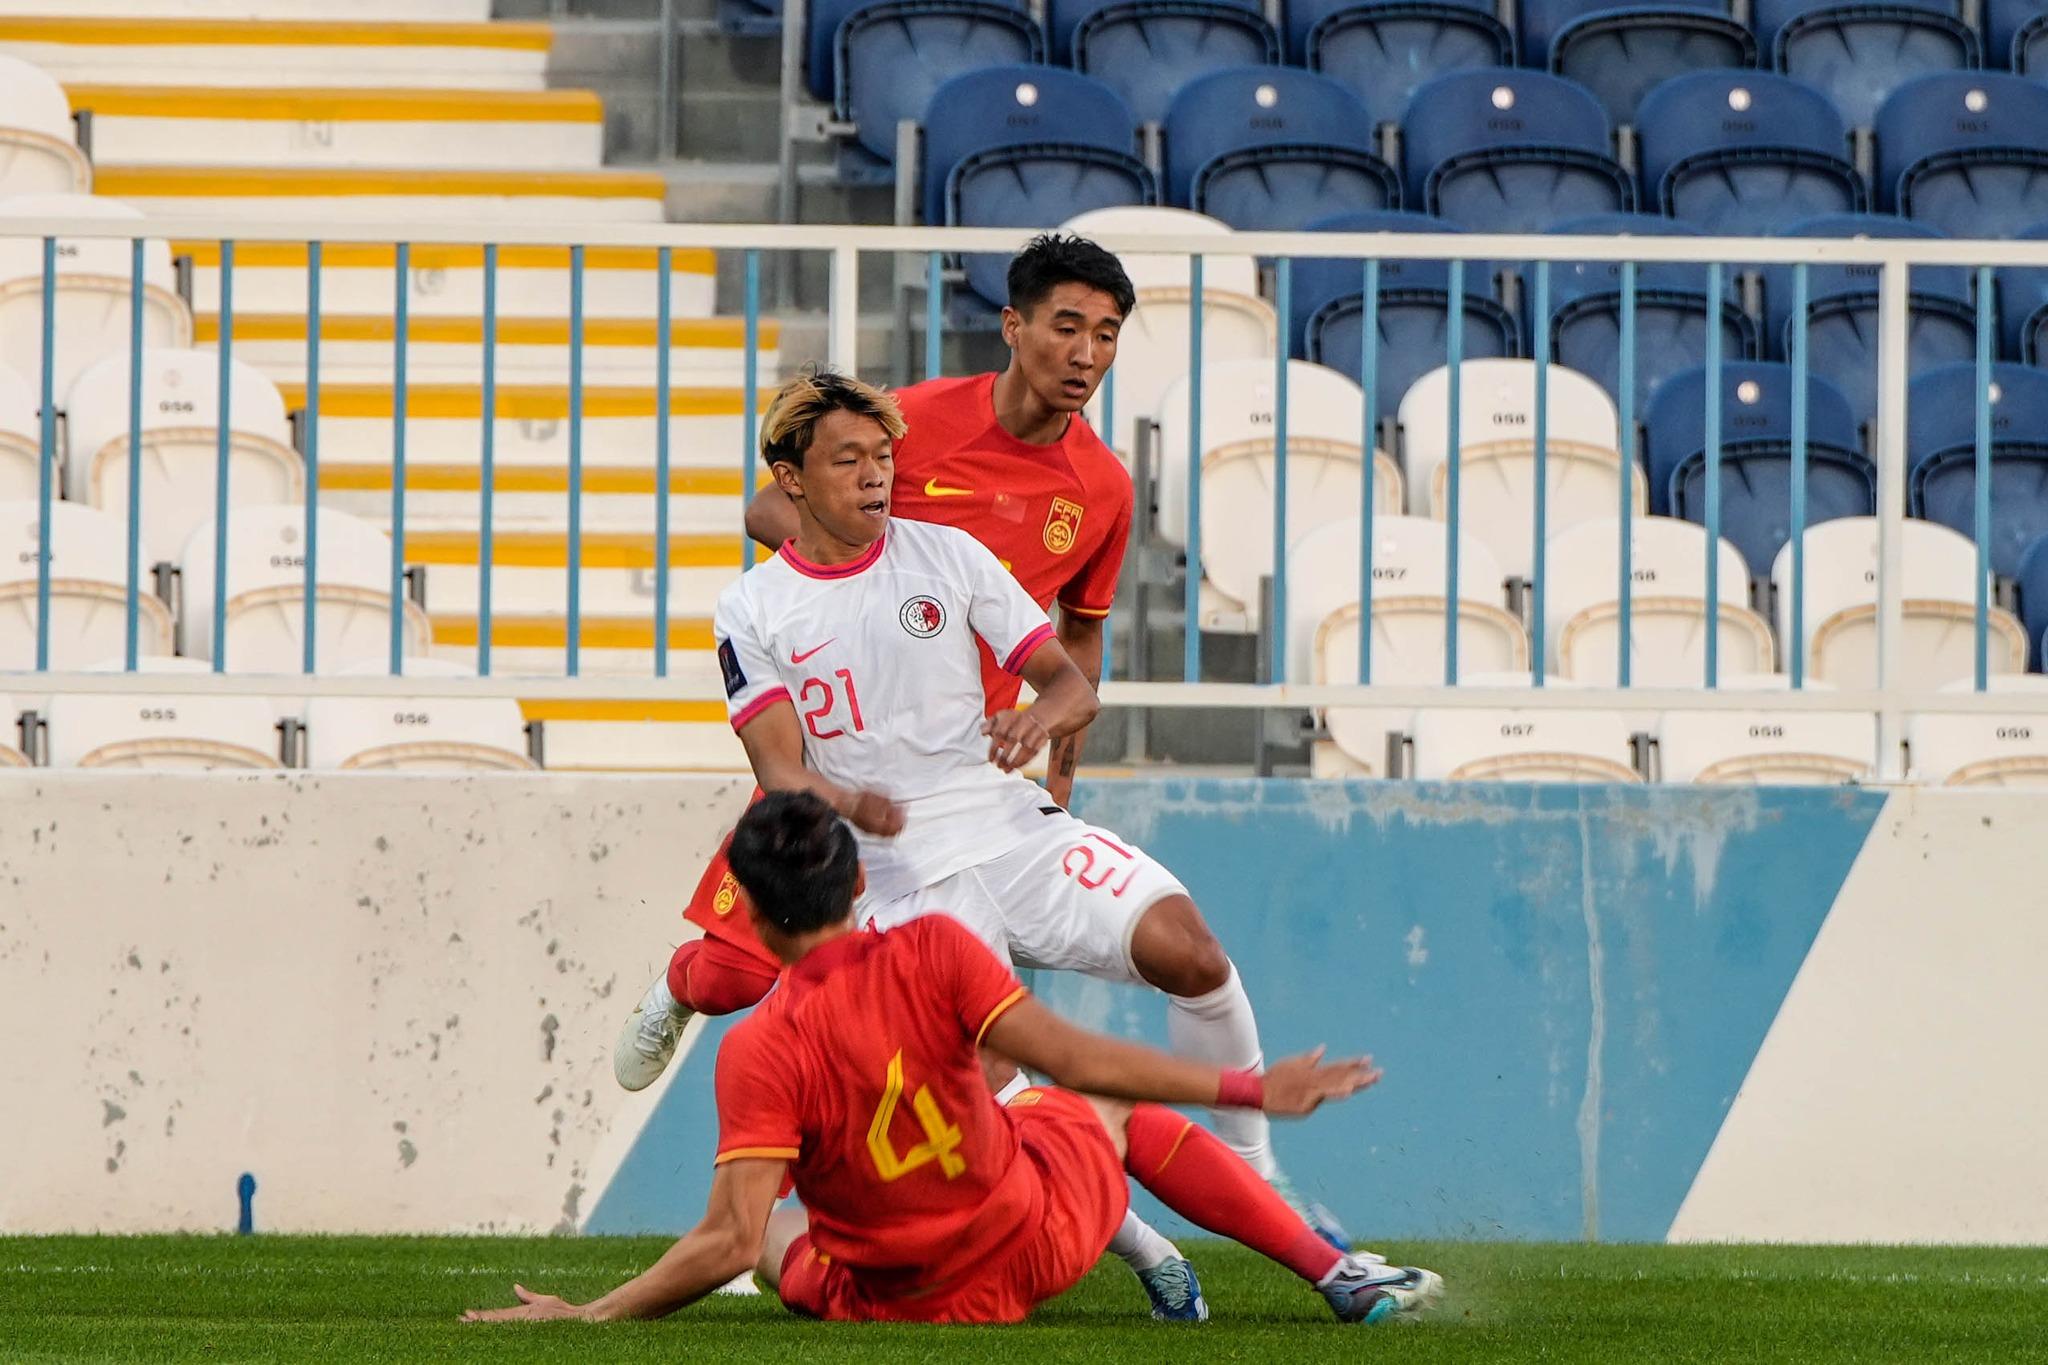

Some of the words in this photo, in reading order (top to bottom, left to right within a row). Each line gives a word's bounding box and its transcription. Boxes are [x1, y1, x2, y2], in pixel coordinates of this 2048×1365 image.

[1250, 413, 1272, 424] 05
[1630, 569, 1656, 581] 58
[800, 668, 864, 739] 21
[1501, 724, 1535, 736] 057
[1749, 725, 1783, 738] 058
[1063, 833, 1134, 889] 21
[867, 1046, 966, 1182] 4
